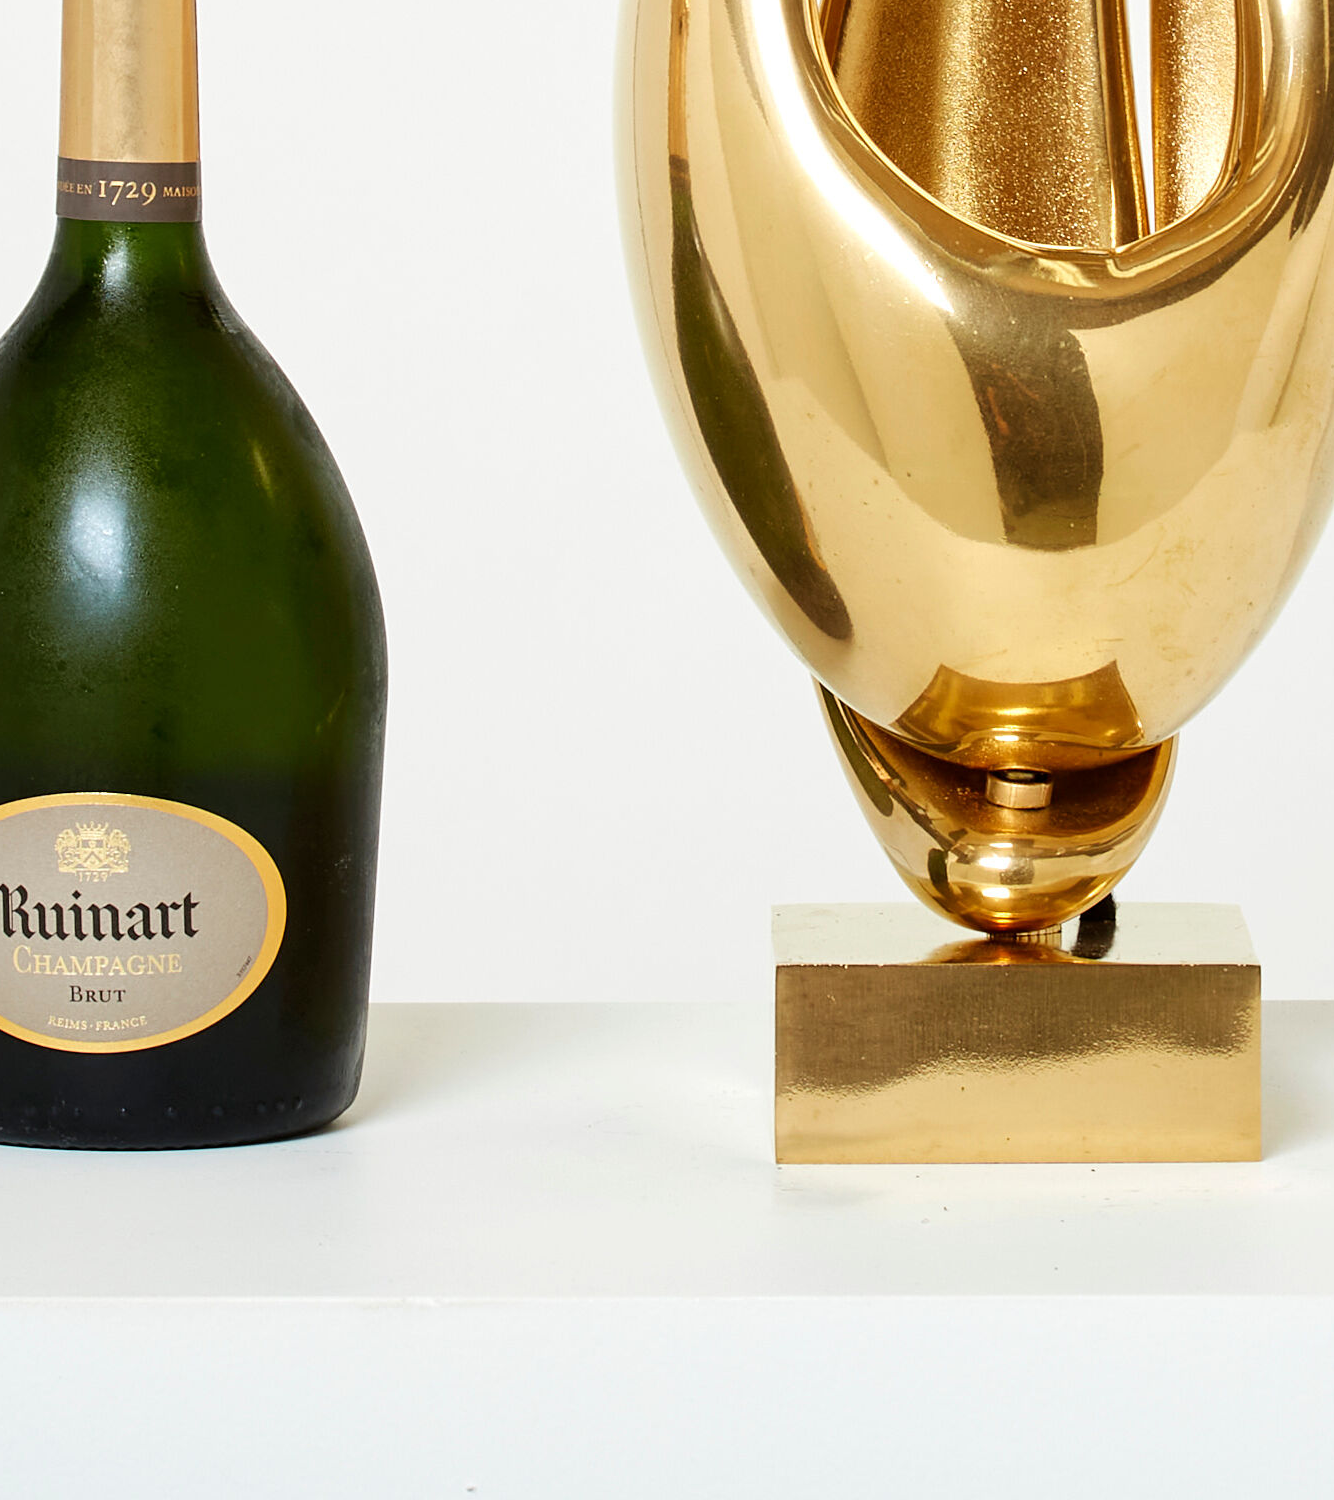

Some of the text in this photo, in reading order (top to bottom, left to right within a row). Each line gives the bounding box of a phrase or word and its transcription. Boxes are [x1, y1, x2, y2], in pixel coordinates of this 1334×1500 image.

[76, 183, 93, 195] EN
[98, 179, 157, 206] 1729
[78, 871, 109, 883] 1729
[12, 945, 184, 976] CHAMPAGNE
[69, 985, 127, 1003] BRUT
